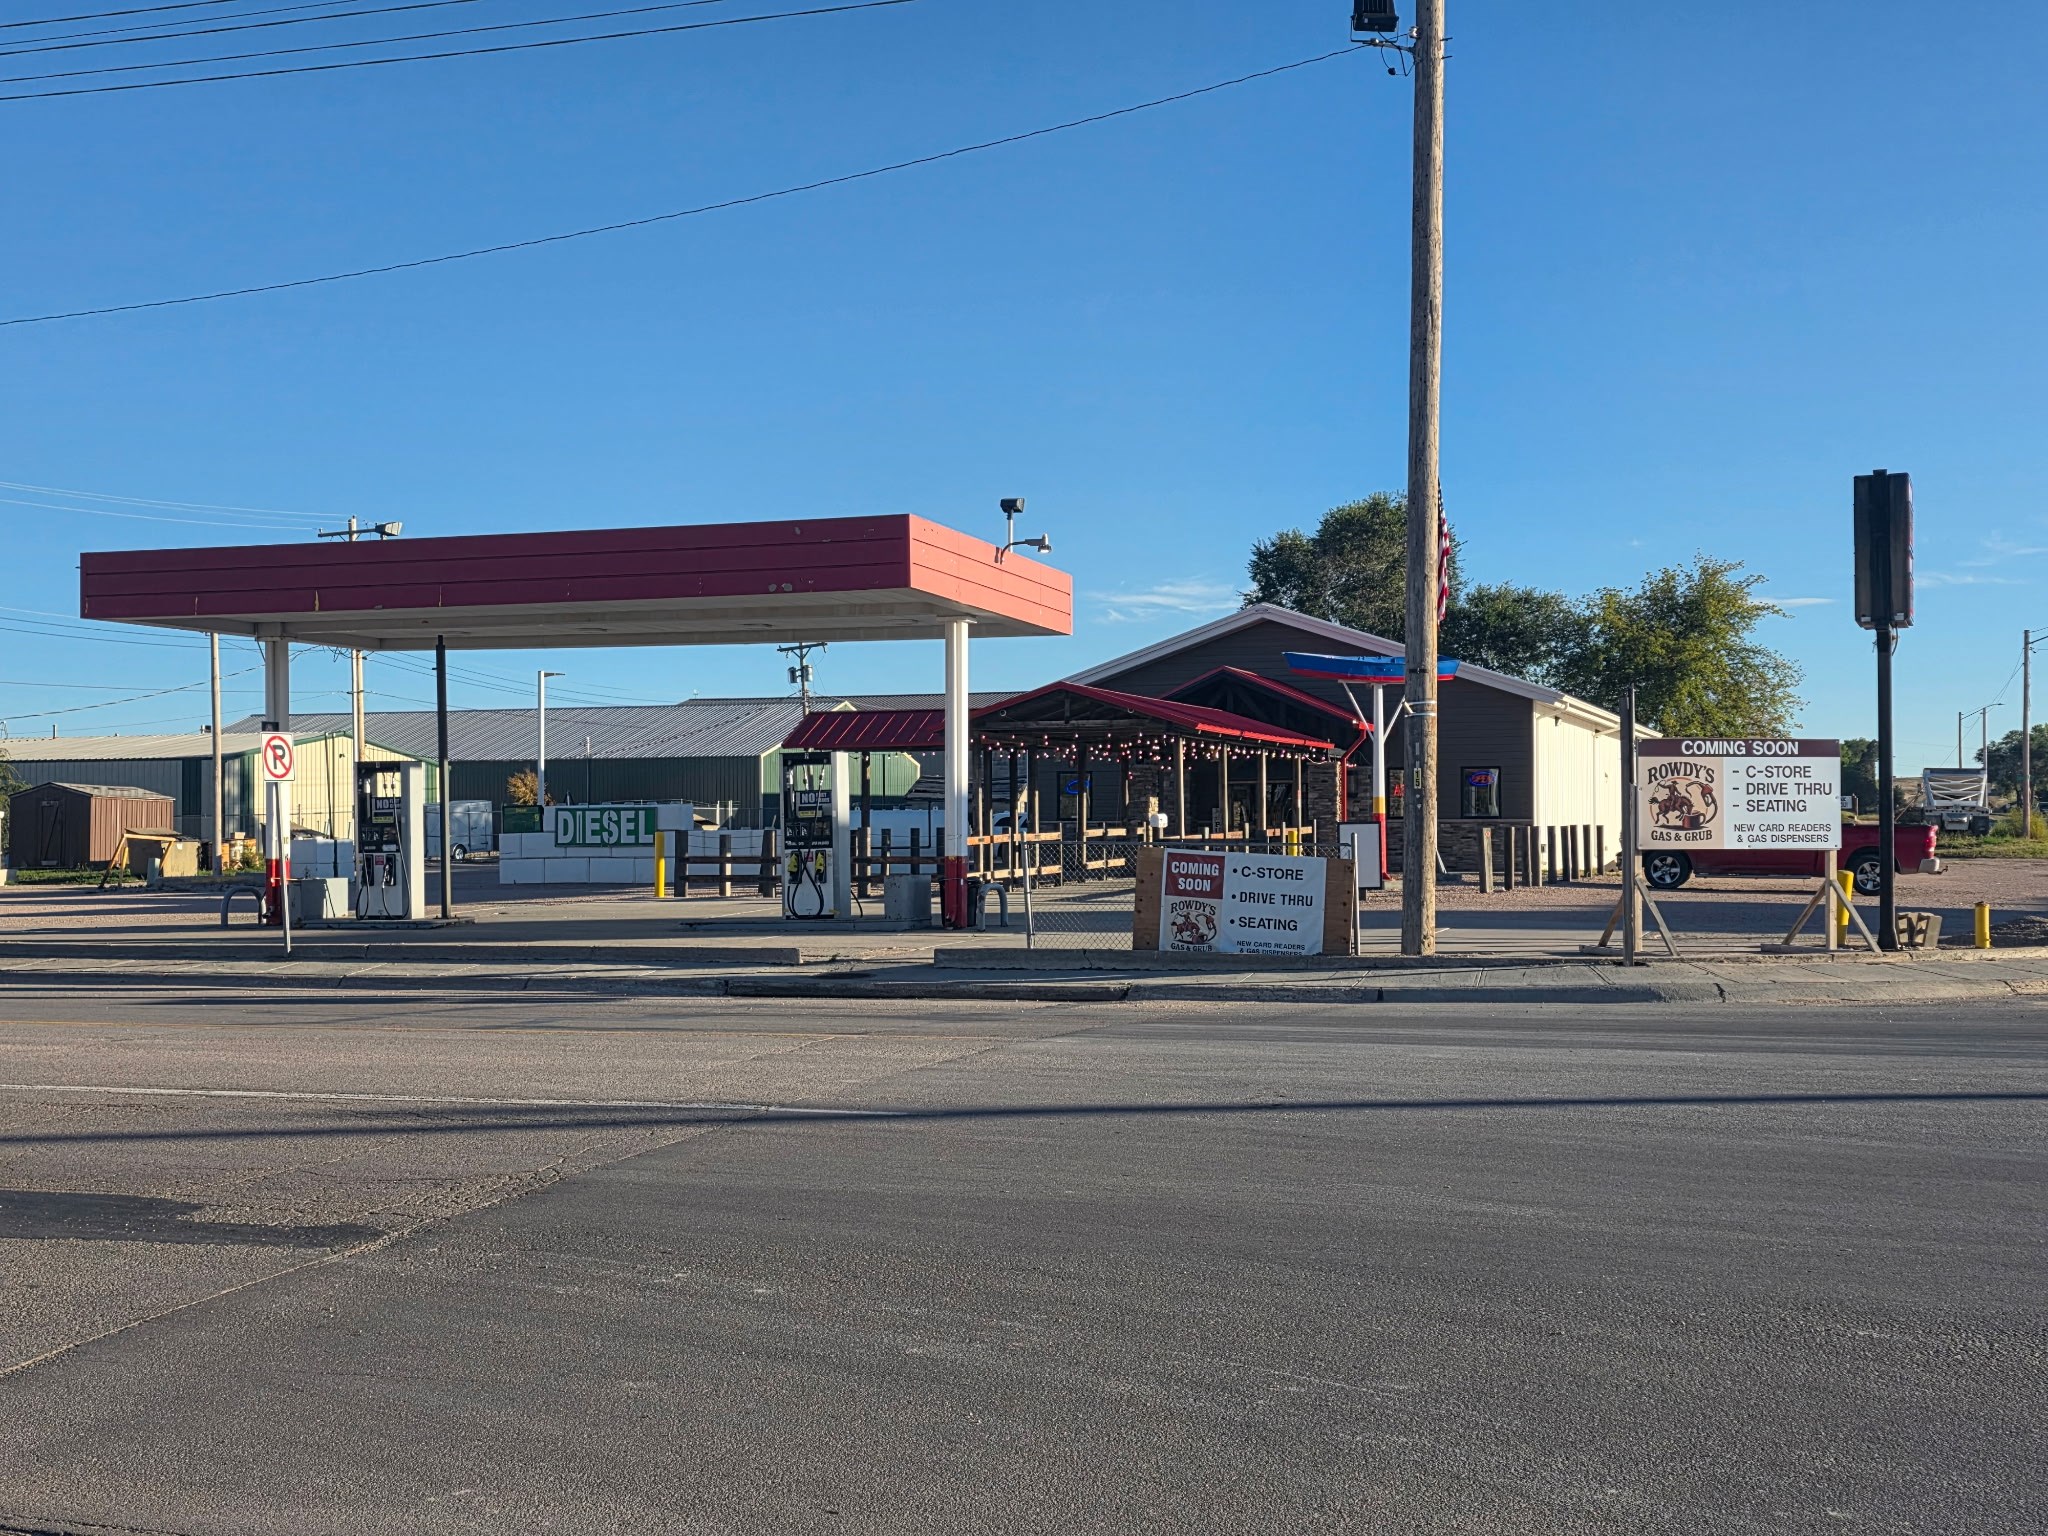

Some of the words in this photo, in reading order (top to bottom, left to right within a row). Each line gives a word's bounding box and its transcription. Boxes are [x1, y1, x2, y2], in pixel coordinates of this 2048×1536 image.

[1681, 740, 1746, 755] COMING
[1752, 740, 1799, 755] SOON
[1647, 761, 1715, 785] ROWDY'S
[1745, 765, 1812, 778] C-STORE
[1746, 782, 1788, 796] DRIVE
[1794, 782, 1832, 796] THRU
[801, 792, 816, 804] NO
[1746, 799, 1807, 813] SEATING
[557, 810, 655, 845] DIESEL
[1733, 823, 1756, 832] NEW
[1758, 823, 1785, 832] CARD
[1788, 823, 1832, 832] READERS
[1651, 830, 1672, 841] GAS
[1674, 832, 1682, 842] &
[1684, 829, 1713, 841] GRUB
[1736, 834, 1744, 843] &
[1747, 834, 1768, 843] GAS
[1770, 834, 1829, 843] DISPENSERS
[1171, 861, 1219, 876] COMING
[1241, 866, 1304, 881] C-STORE
[1177, 877, 1211, 892] SOON
[1239, 891, 1276, 905] DRIVE
[1281, 893, 1313, 907] THRU
[1169, 900, 1217, 916] ROWDY'S
[1238, 916, 1298, 932] SEATING
[1170, 942, 1185, 951] GAS
[1192, 944, 1213, 952] GRUB
[1253, 941, 1272, 949] CARD
[1273, 943, 1306, 951] READERS
